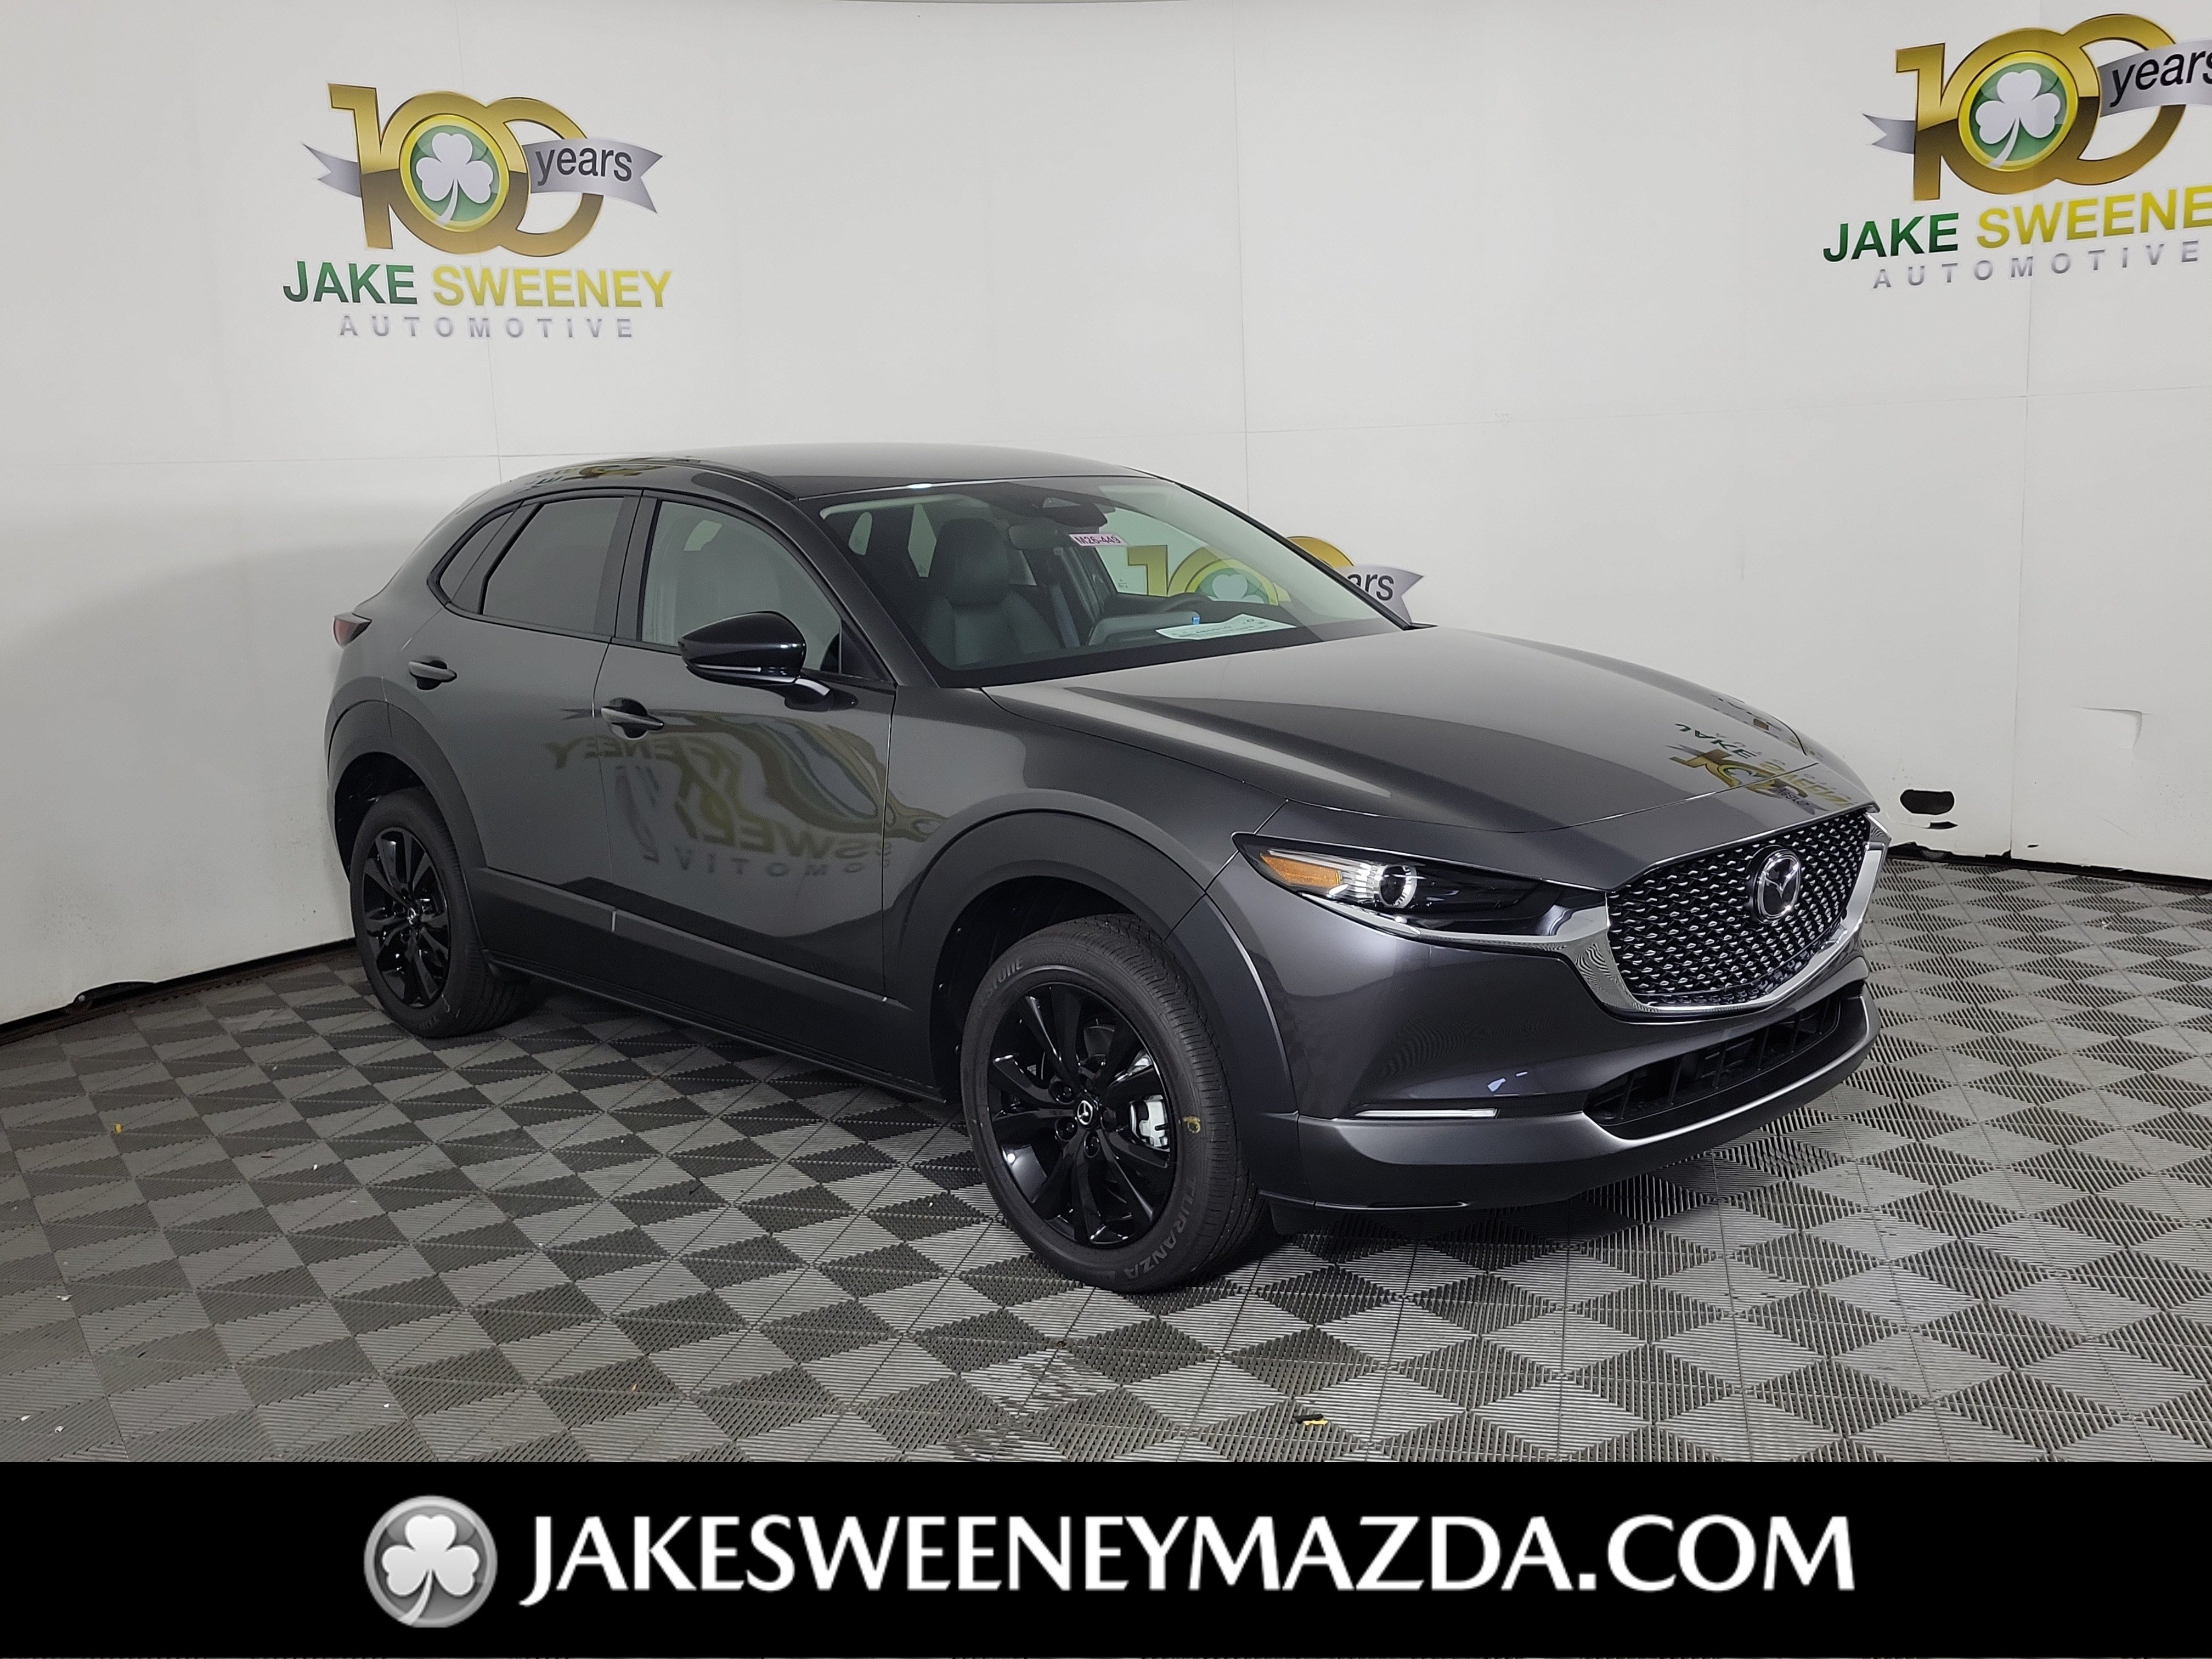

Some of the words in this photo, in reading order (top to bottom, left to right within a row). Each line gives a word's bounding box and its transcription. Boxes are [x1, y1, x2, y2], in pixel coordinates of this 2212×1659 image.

[1896, 14, 2186, 201] 100
[328, 83, 604, 257] 100
[536, 148, 633, 185] years
[1823, 212, 1959, 262] JAKE
[283, 261, 417, 305] JAKE
[432, 265, 673, 308] SWEENEY
[1873, 240, 2199, 289] AUTOMOTIVE
[340, 315, 632, 338] AUTOMOTIVE
[1074, 535, 1121, 545] M26-449
[1124, 1177, 1198, 1279] TURANZA
